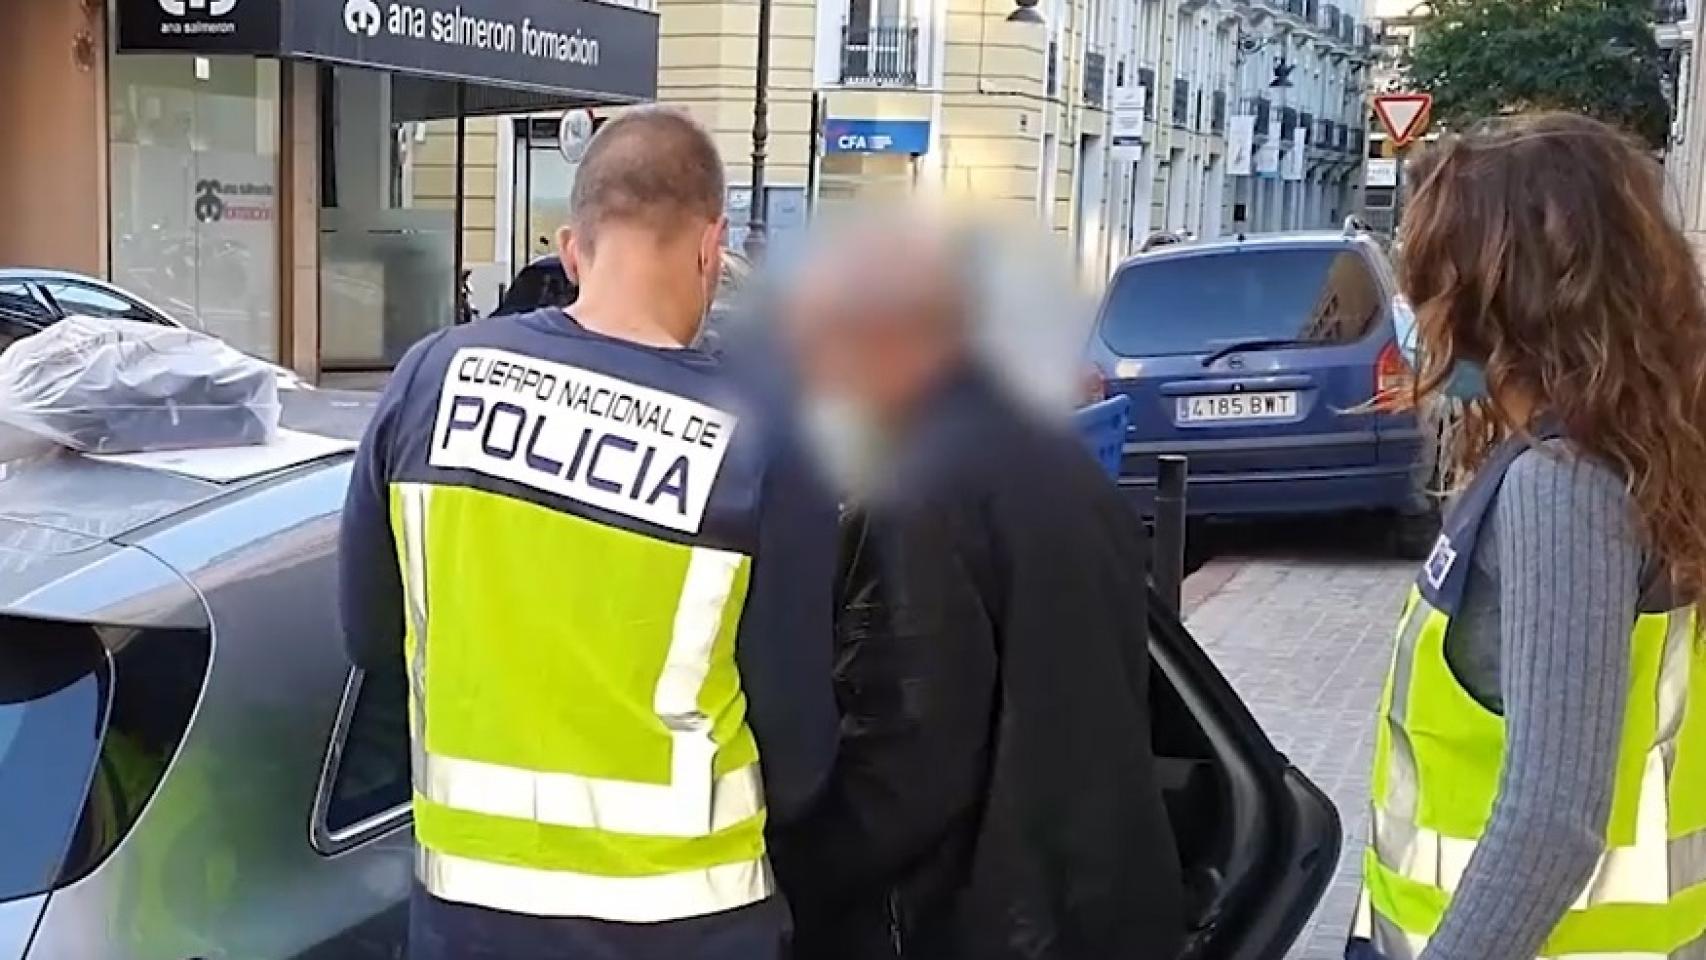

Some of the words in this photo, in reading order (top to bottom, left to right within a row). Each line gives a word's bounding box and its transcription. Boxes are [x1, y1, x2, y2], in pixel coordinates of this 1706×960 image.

[161, 22, 181, 33] ana
[388, 3, 425, 38] ana
[431, 6, 516, 52] salmeron
[521, 17, 599, 66] formacion
[838, 135, 867, 149] CFA
[458, 356, 556, 401] CUERPO
[557, 378, 674, 437] NACIONAL
[681, 414, 722, 449] DE
[1192, 397, 1243, 417] 4185
[1250, 395, 1290, 415] BWT
[441, 395, 689, 515] POLICIA
